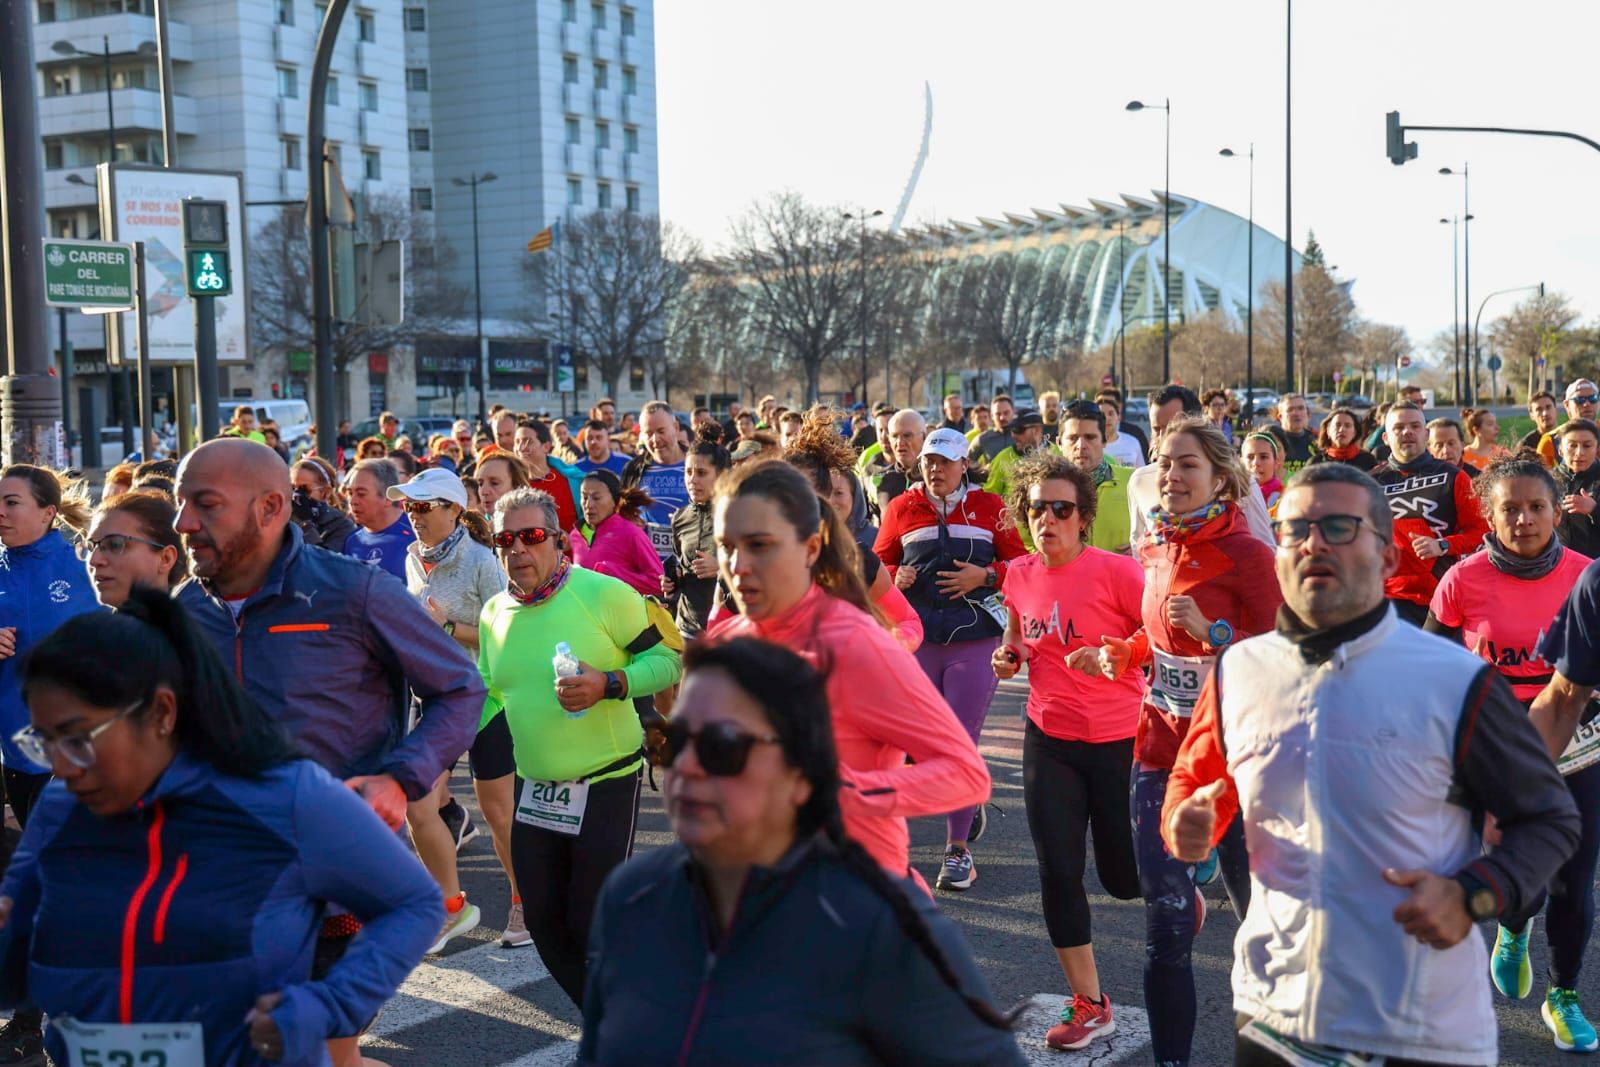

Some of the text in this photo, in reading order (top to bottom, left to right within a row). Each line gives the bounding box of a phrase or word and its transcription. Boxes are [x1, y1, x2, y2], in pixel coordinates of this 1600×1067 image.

[68, 250, 125, 265] CARRER
[77, 268, 101, 280] DEL
[652, 533, 673, 546] 63
[1160, 663, 1199, 690] 853
[1575, 723, 1600, 744] 15
[532, 782, 571, 806] 204
